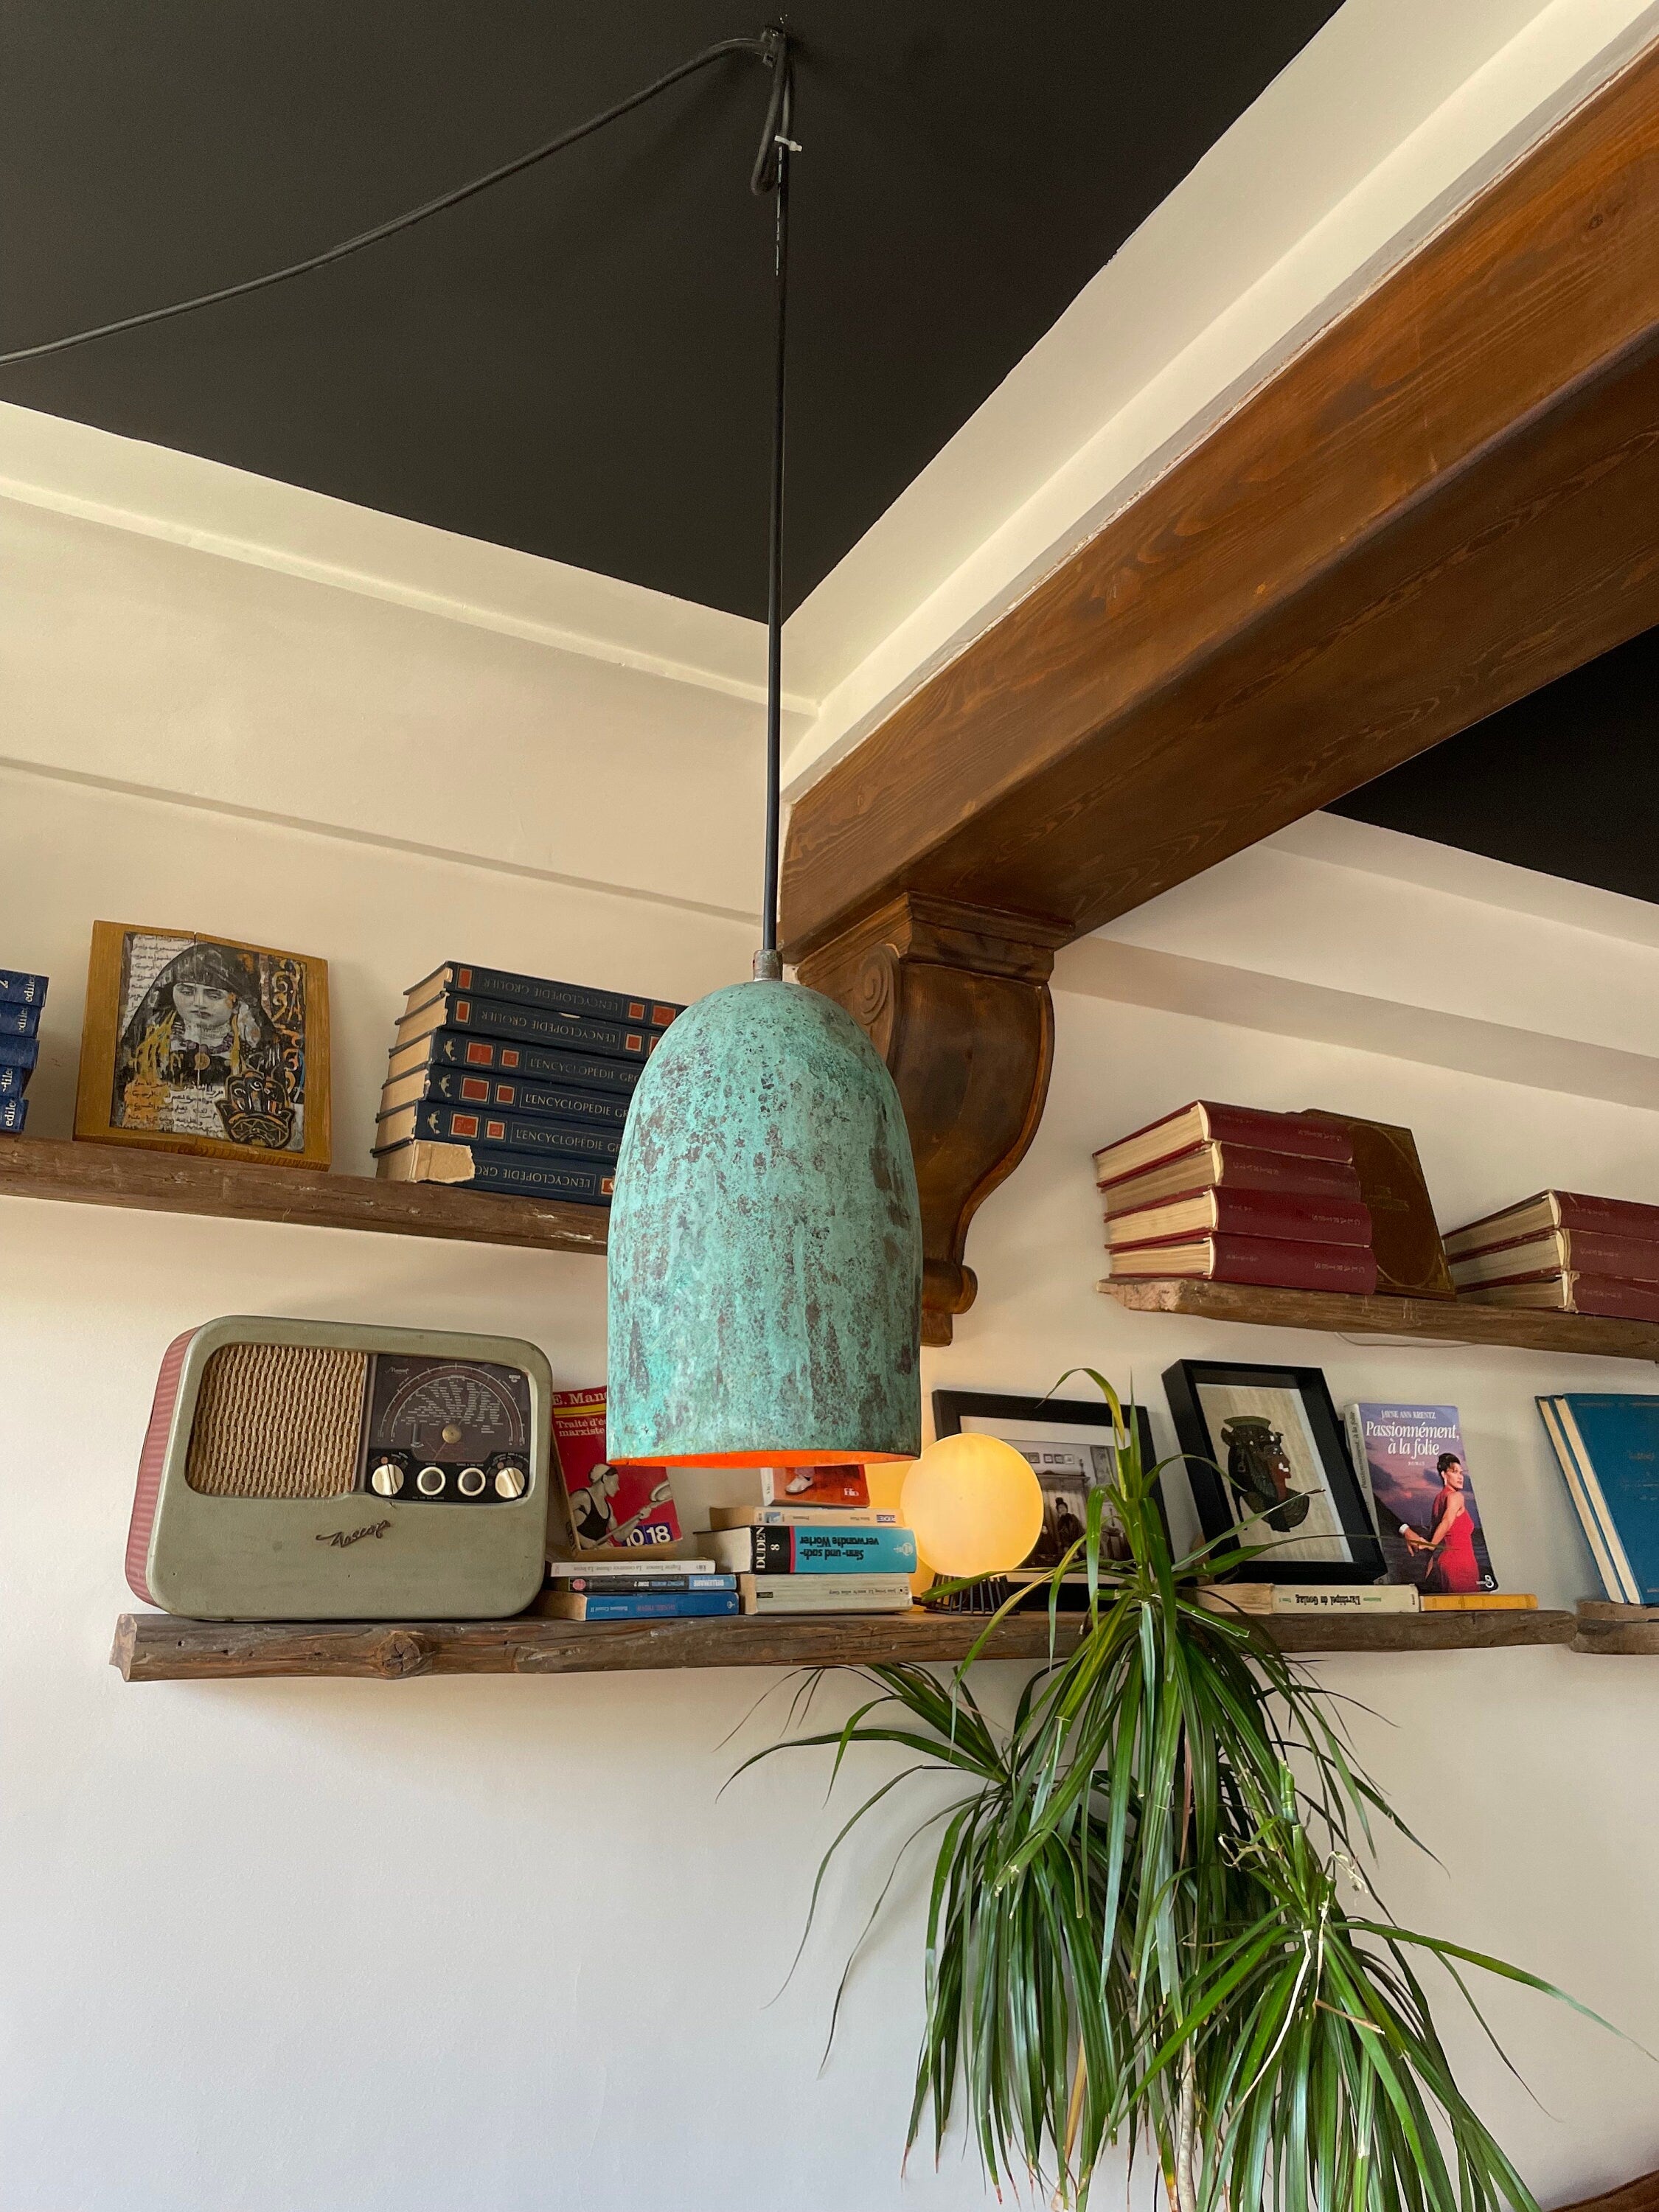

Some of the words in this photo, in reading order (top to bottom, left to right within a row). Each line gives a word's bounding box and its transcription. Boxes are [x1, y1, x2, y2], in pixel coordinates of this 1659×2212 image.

[483, 977, 530, 995] GROLIER
[481, 1009, 527, 1027] GROLIER
[552, 1394, 567, 1405] E.
[555, 1419, 588, 1429] Traité
[559, 1427, 605, 1437] marxiste
[1366, 1421, 1460, 1441] Passionnément,
[1388, 1438, 1396, 1455] à
[1399, 1438, 1411, 1455] la
[1411, 1439, 1439, 1460] folie
[646, 1526, 671, 1544] 18
[756, 1526, 766, 1569] DUDEN
[771, 1543, 780, 1551] 8
[799, 1537, 831, 1548] Wörter
[832, 1537, 880, 1548] verwandte
[800, 1549, 822, 1560] sach-
[824, 1549, 841, 1560] und
[842, 1549, 864, 1560] Sinn-
[1295, 1594, 1318, 1606] Goulag
